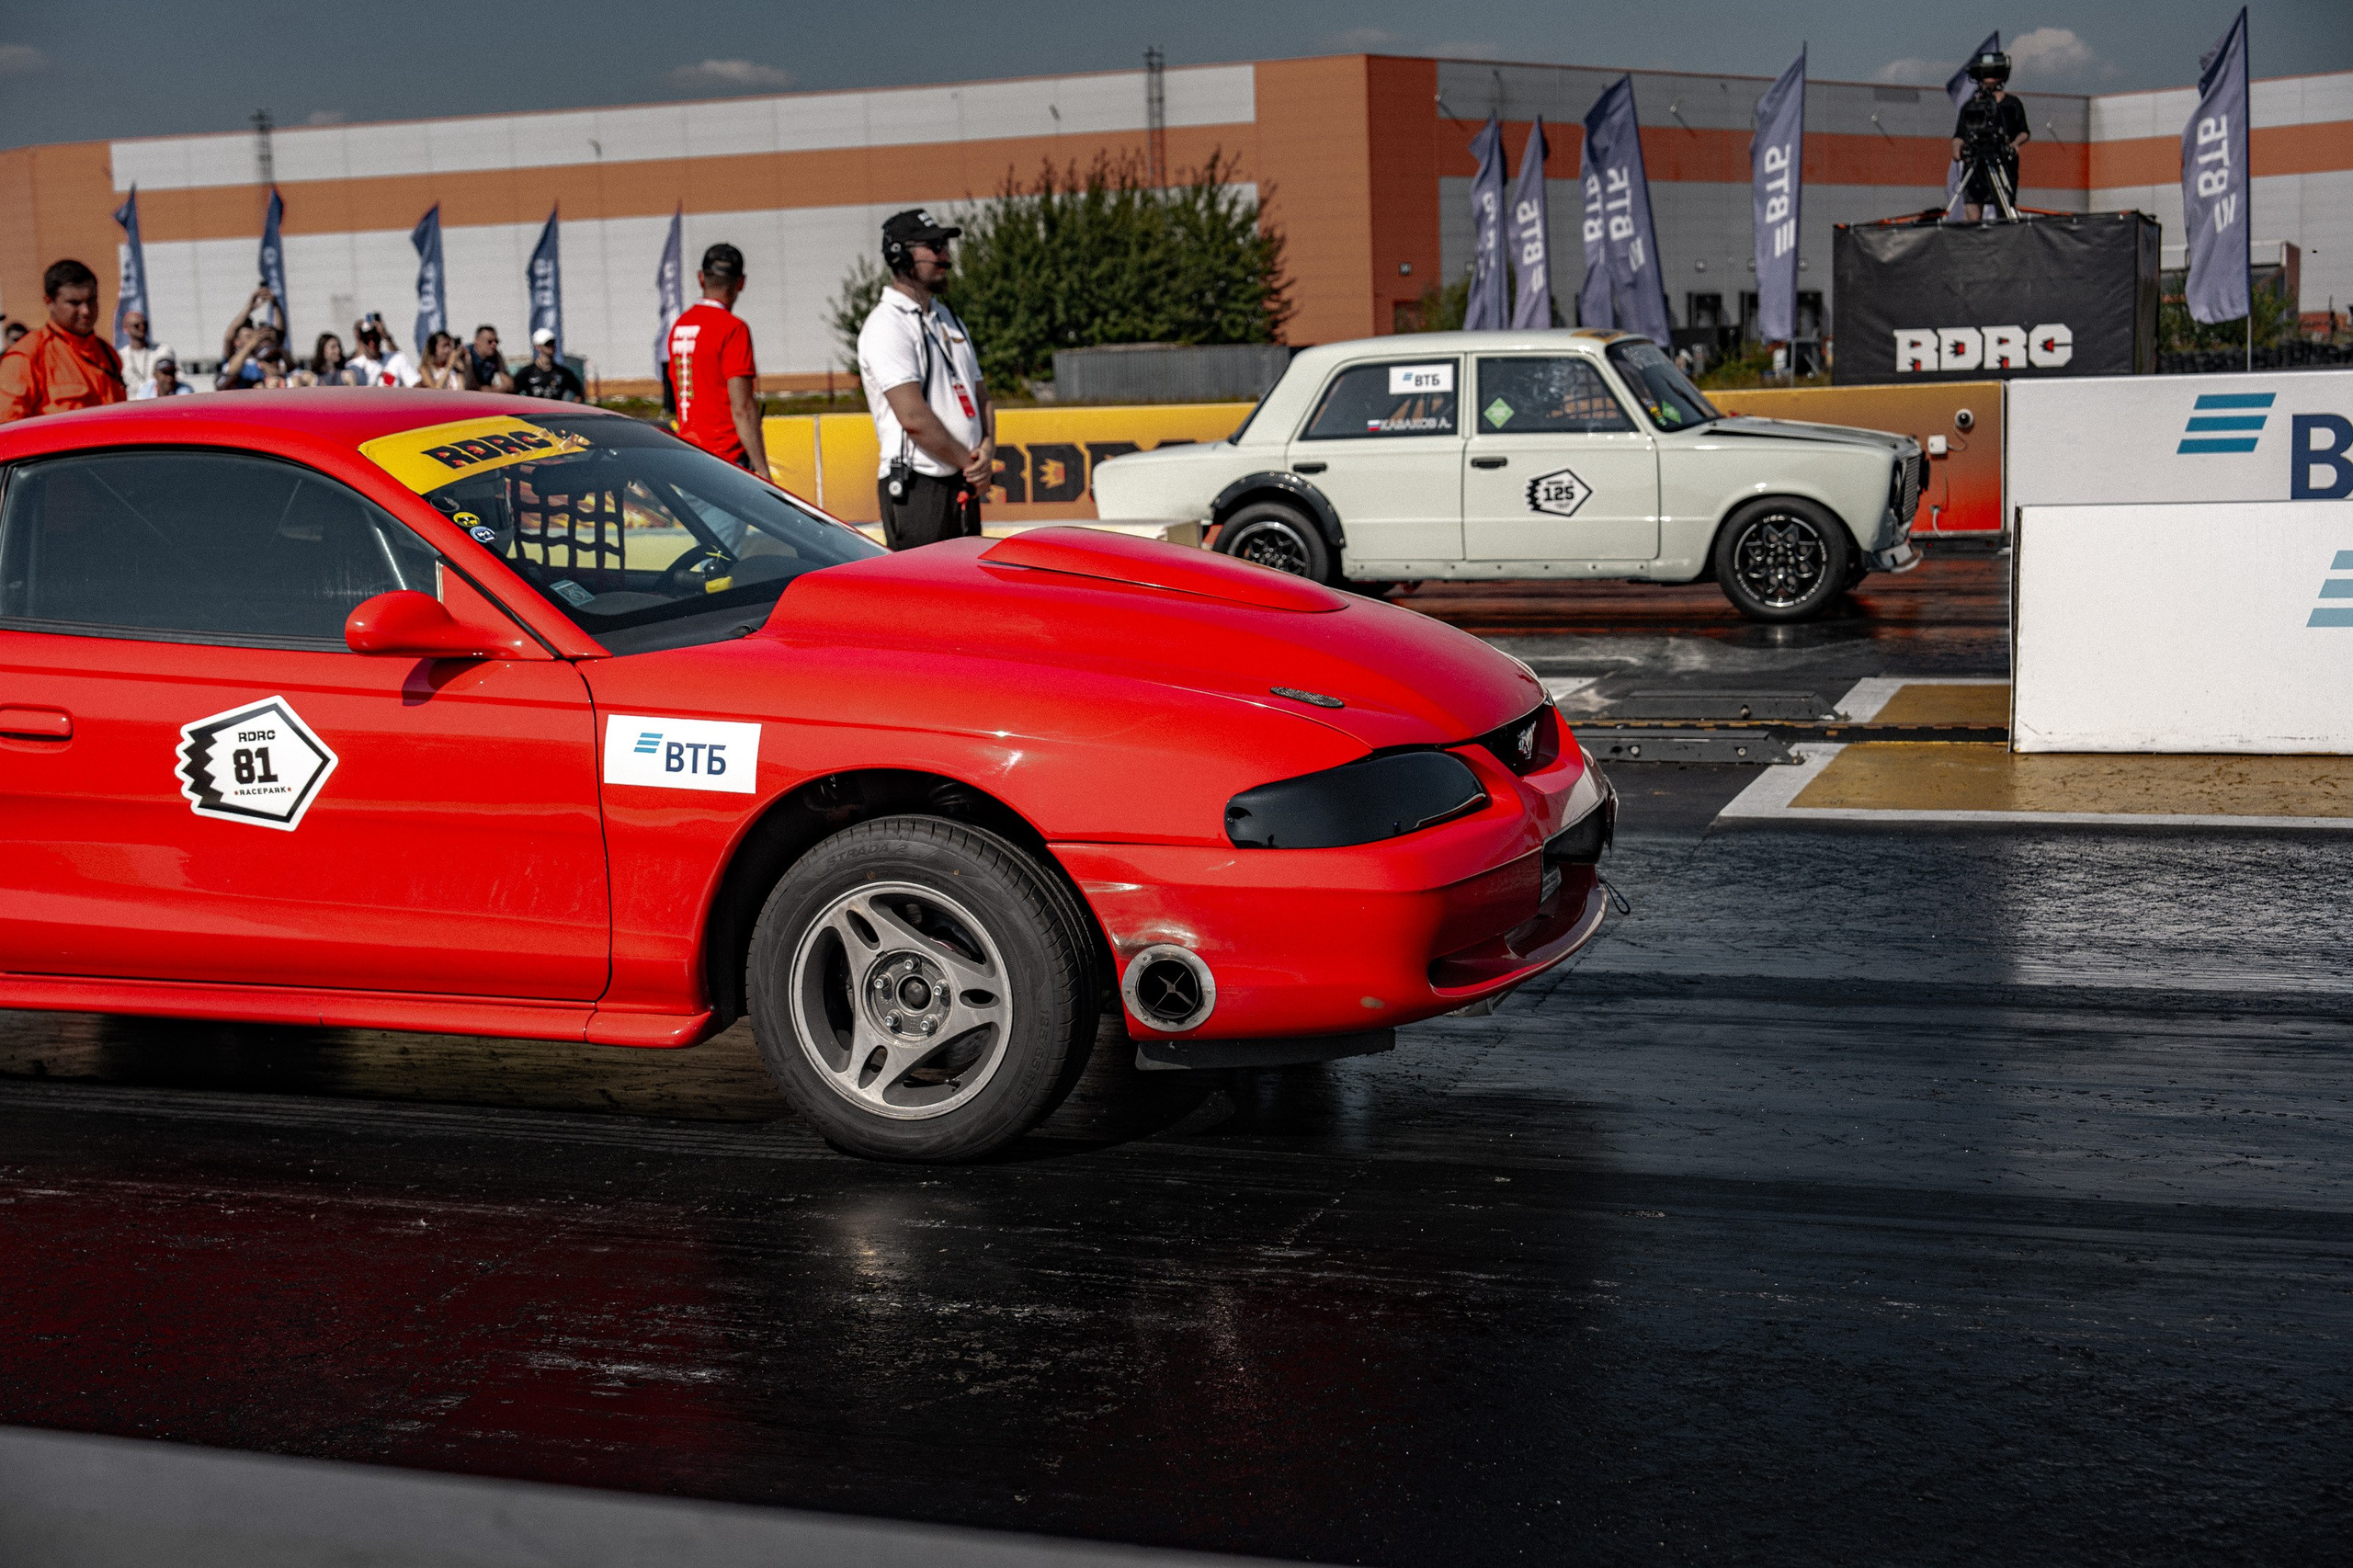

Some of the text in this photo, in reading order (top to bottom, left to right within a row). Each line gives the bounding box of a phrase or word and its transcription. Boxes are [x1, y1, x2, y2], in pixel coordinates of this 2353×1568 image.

[1893, 323, 2074, 373] RDRC
[1414, 373, 1440, 387] ВТБ
[420, 430, 553, 470] RDRC
[1543, 484, 1574, 502] 125
[238, 729, 276, 743] RDRC
[233, 746, 278, 785] 81
[665, 741, 727, 776] ВТБ
[239, 786, 287, 796] RACEPARK
[828, 843, 909, 865] STRADA 2
